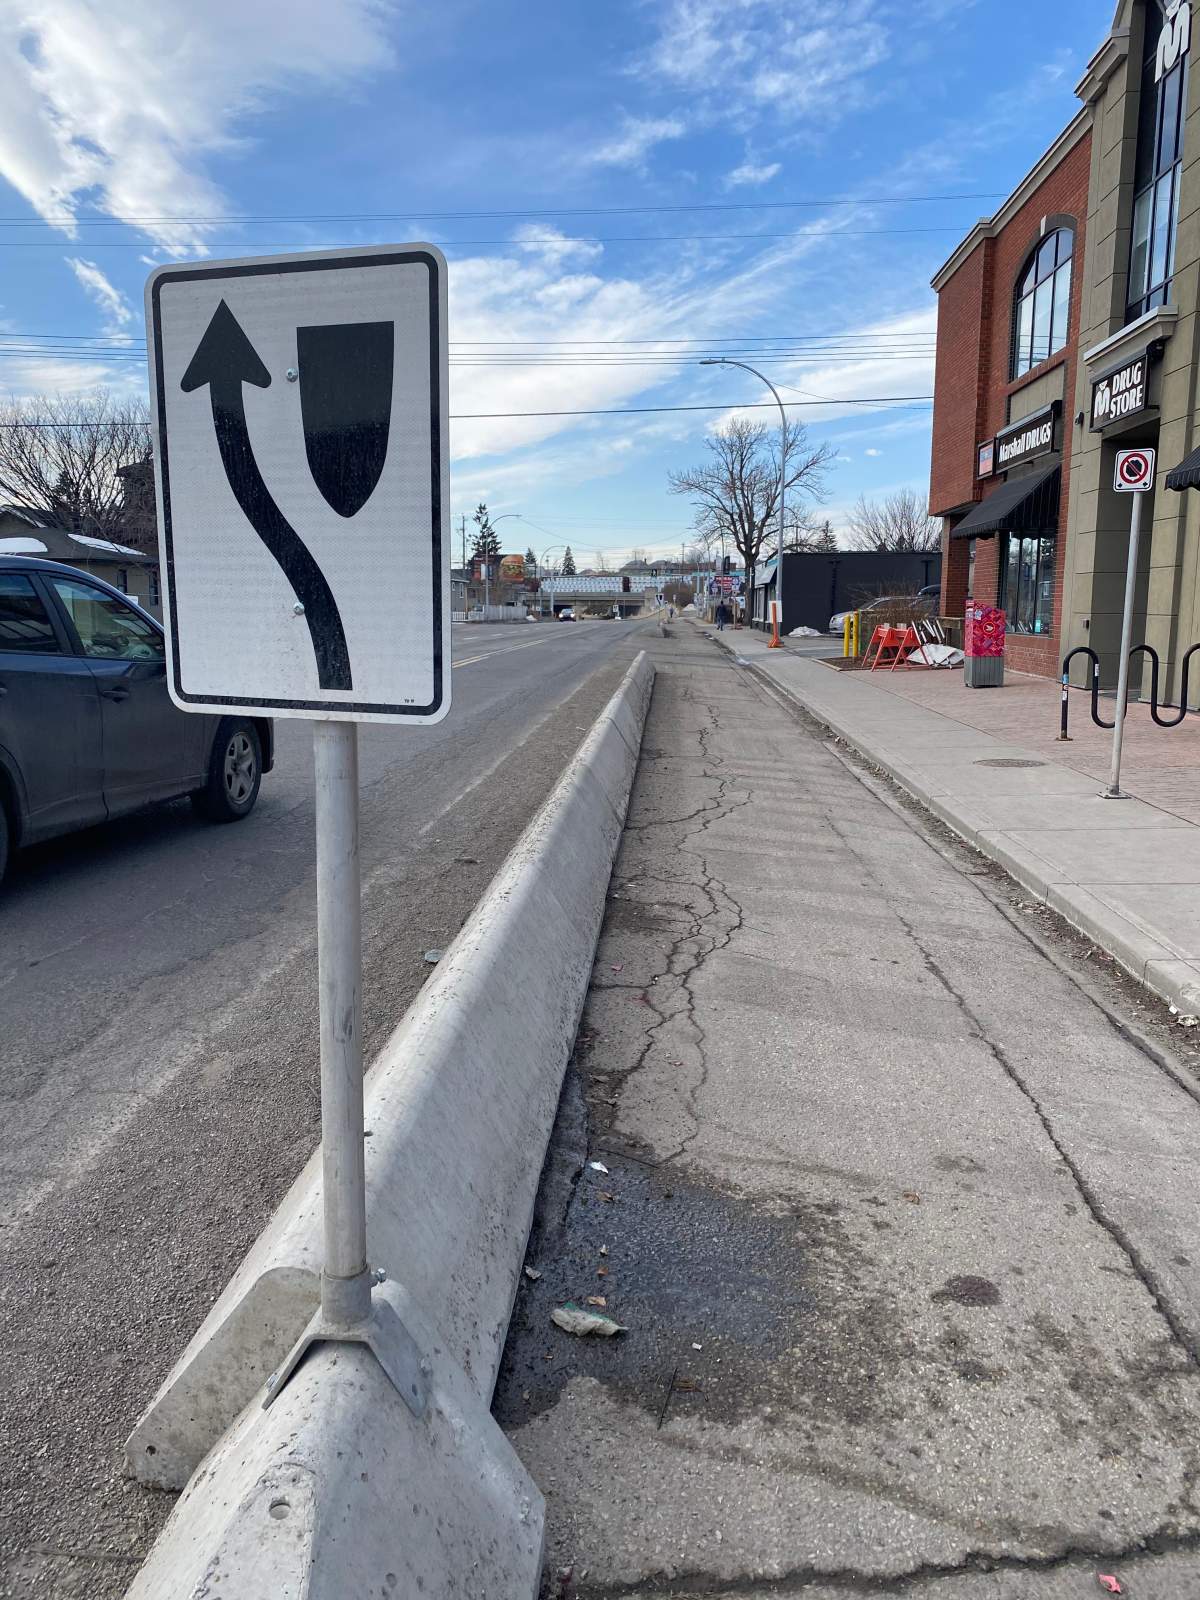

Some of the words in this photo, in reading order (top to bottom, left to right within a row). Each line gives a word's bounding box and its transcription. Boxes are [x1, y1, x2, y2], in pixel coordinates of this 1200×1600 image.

[1112, 362, 1142, 396] DRUG
[1110, 384, 1143, 419] STORE
[998, 433, 1026, 464] Marshall
[1026, 421, 1052, 451] DRUGS
